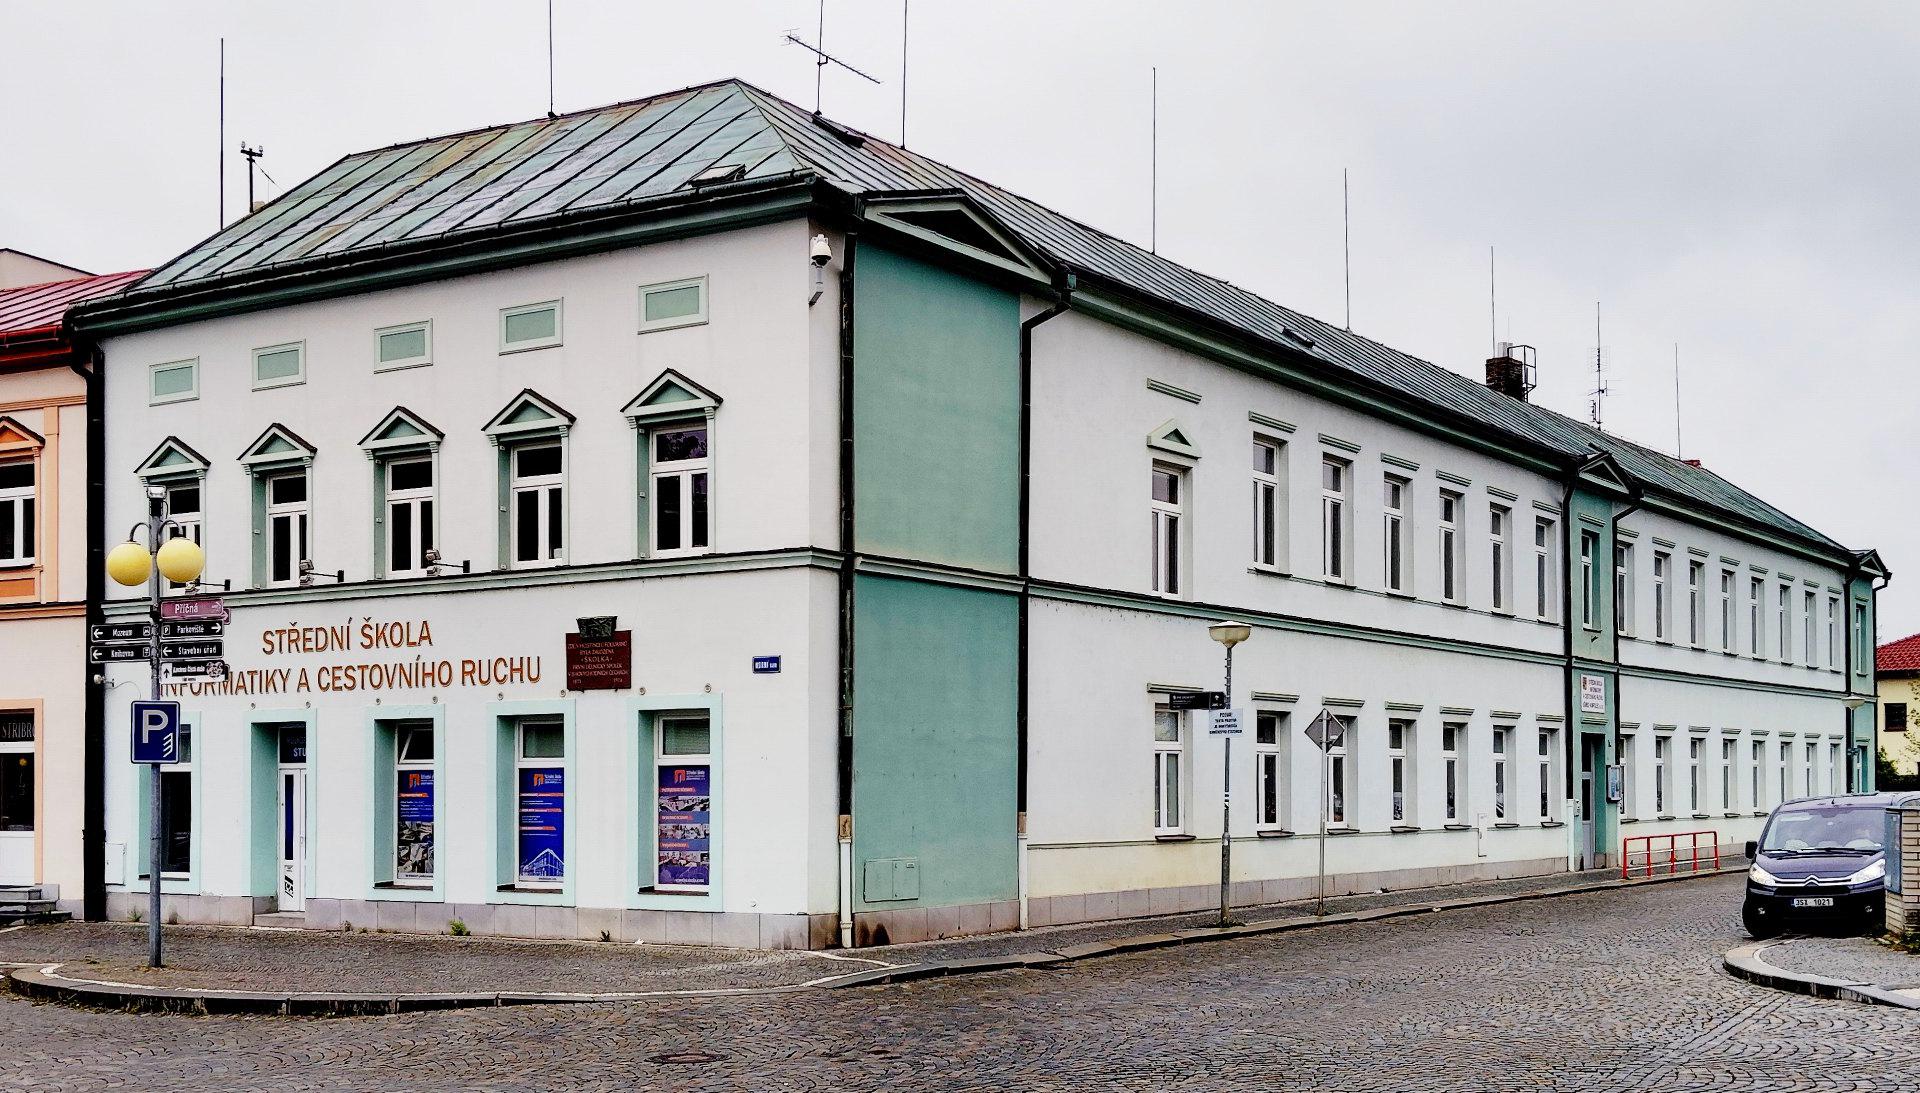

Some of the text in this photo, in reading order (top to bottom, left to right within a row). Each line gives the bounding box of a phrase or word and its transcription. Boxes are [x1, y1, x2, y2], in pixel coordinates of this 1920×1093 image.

[174, 602, 199, 614] Příčná
[262, 617, 434, 656] STŘEDNÍ ŠKOLA
[297, 667, 311, 693] A
[317, 654, 452, 692] CESTOVNÍHO
[462, 655, 541, 687] RUCHU
[142, 709, 169, 744] P
[1813, 898, 1830, 906] 1021
